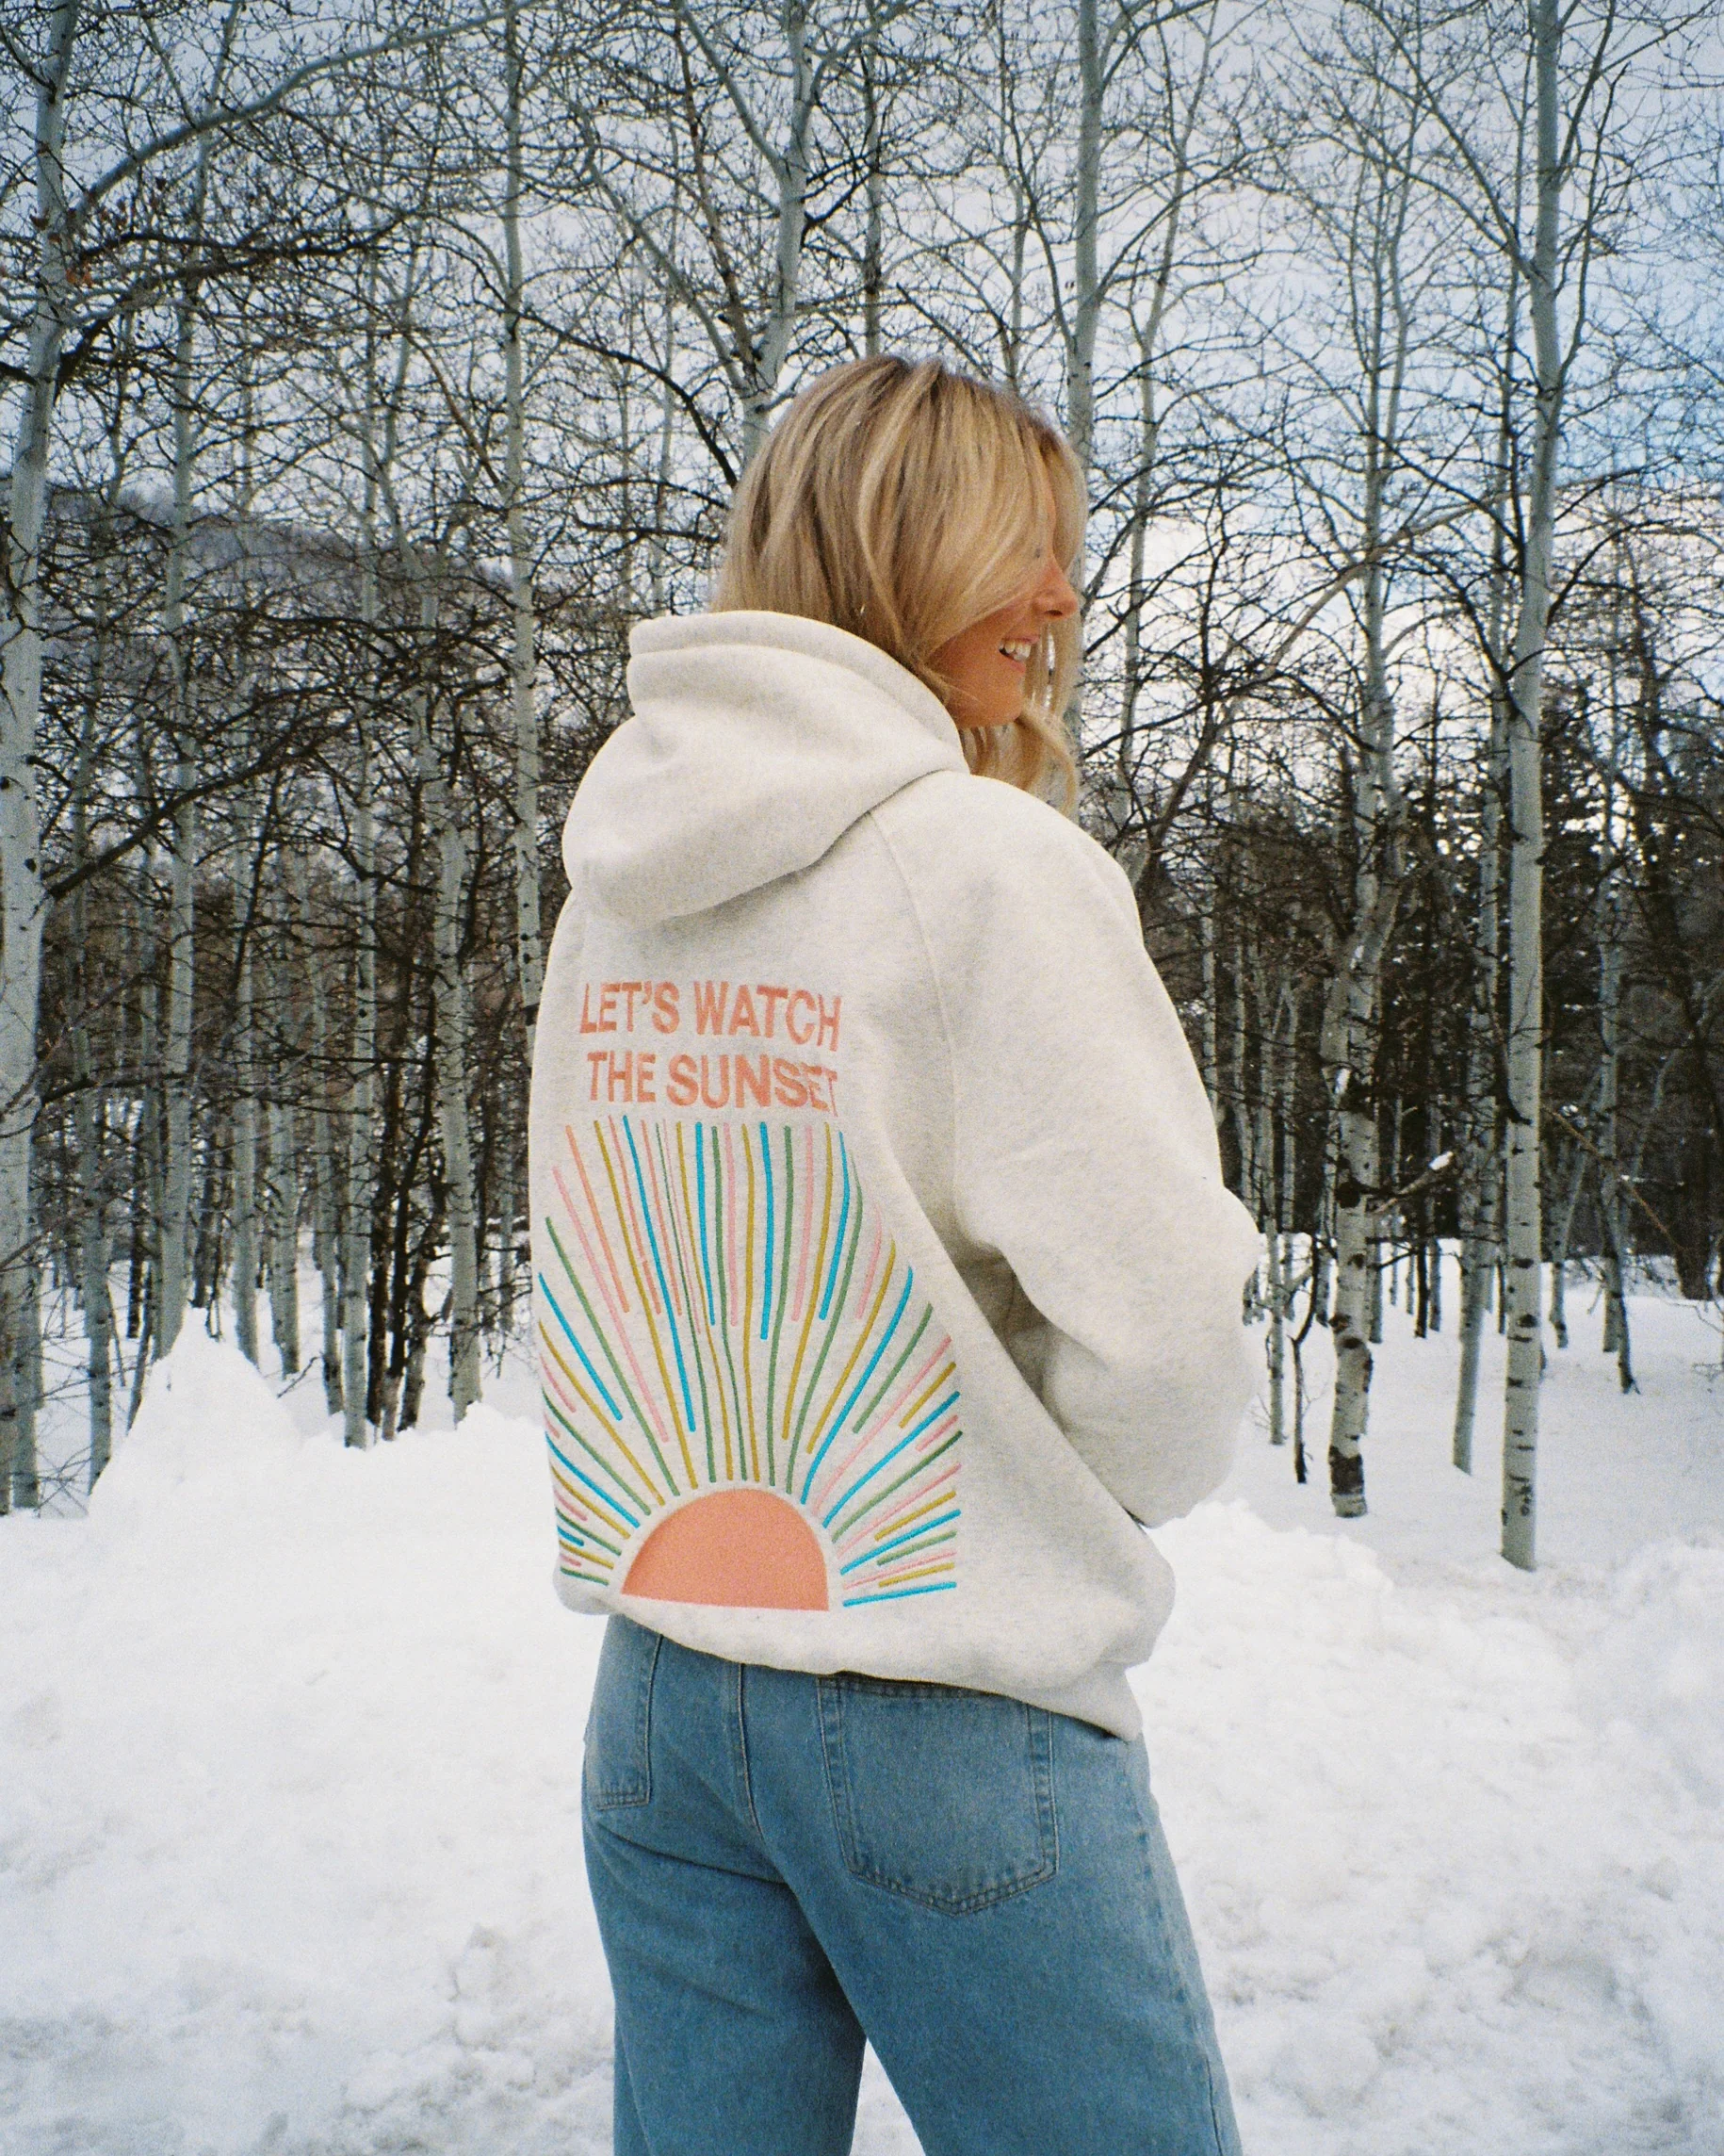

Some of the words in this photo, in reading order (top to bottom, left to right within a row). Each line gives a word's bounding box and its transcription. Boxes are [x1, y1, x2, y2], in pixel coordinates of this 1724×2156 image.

[580, 981, 680, 1034] LET'S
[693, 981, 842, 1052] WATCH
[587, 1050, 657, 1102] THE
[666, 1054, 838, 1118] SUNSET
